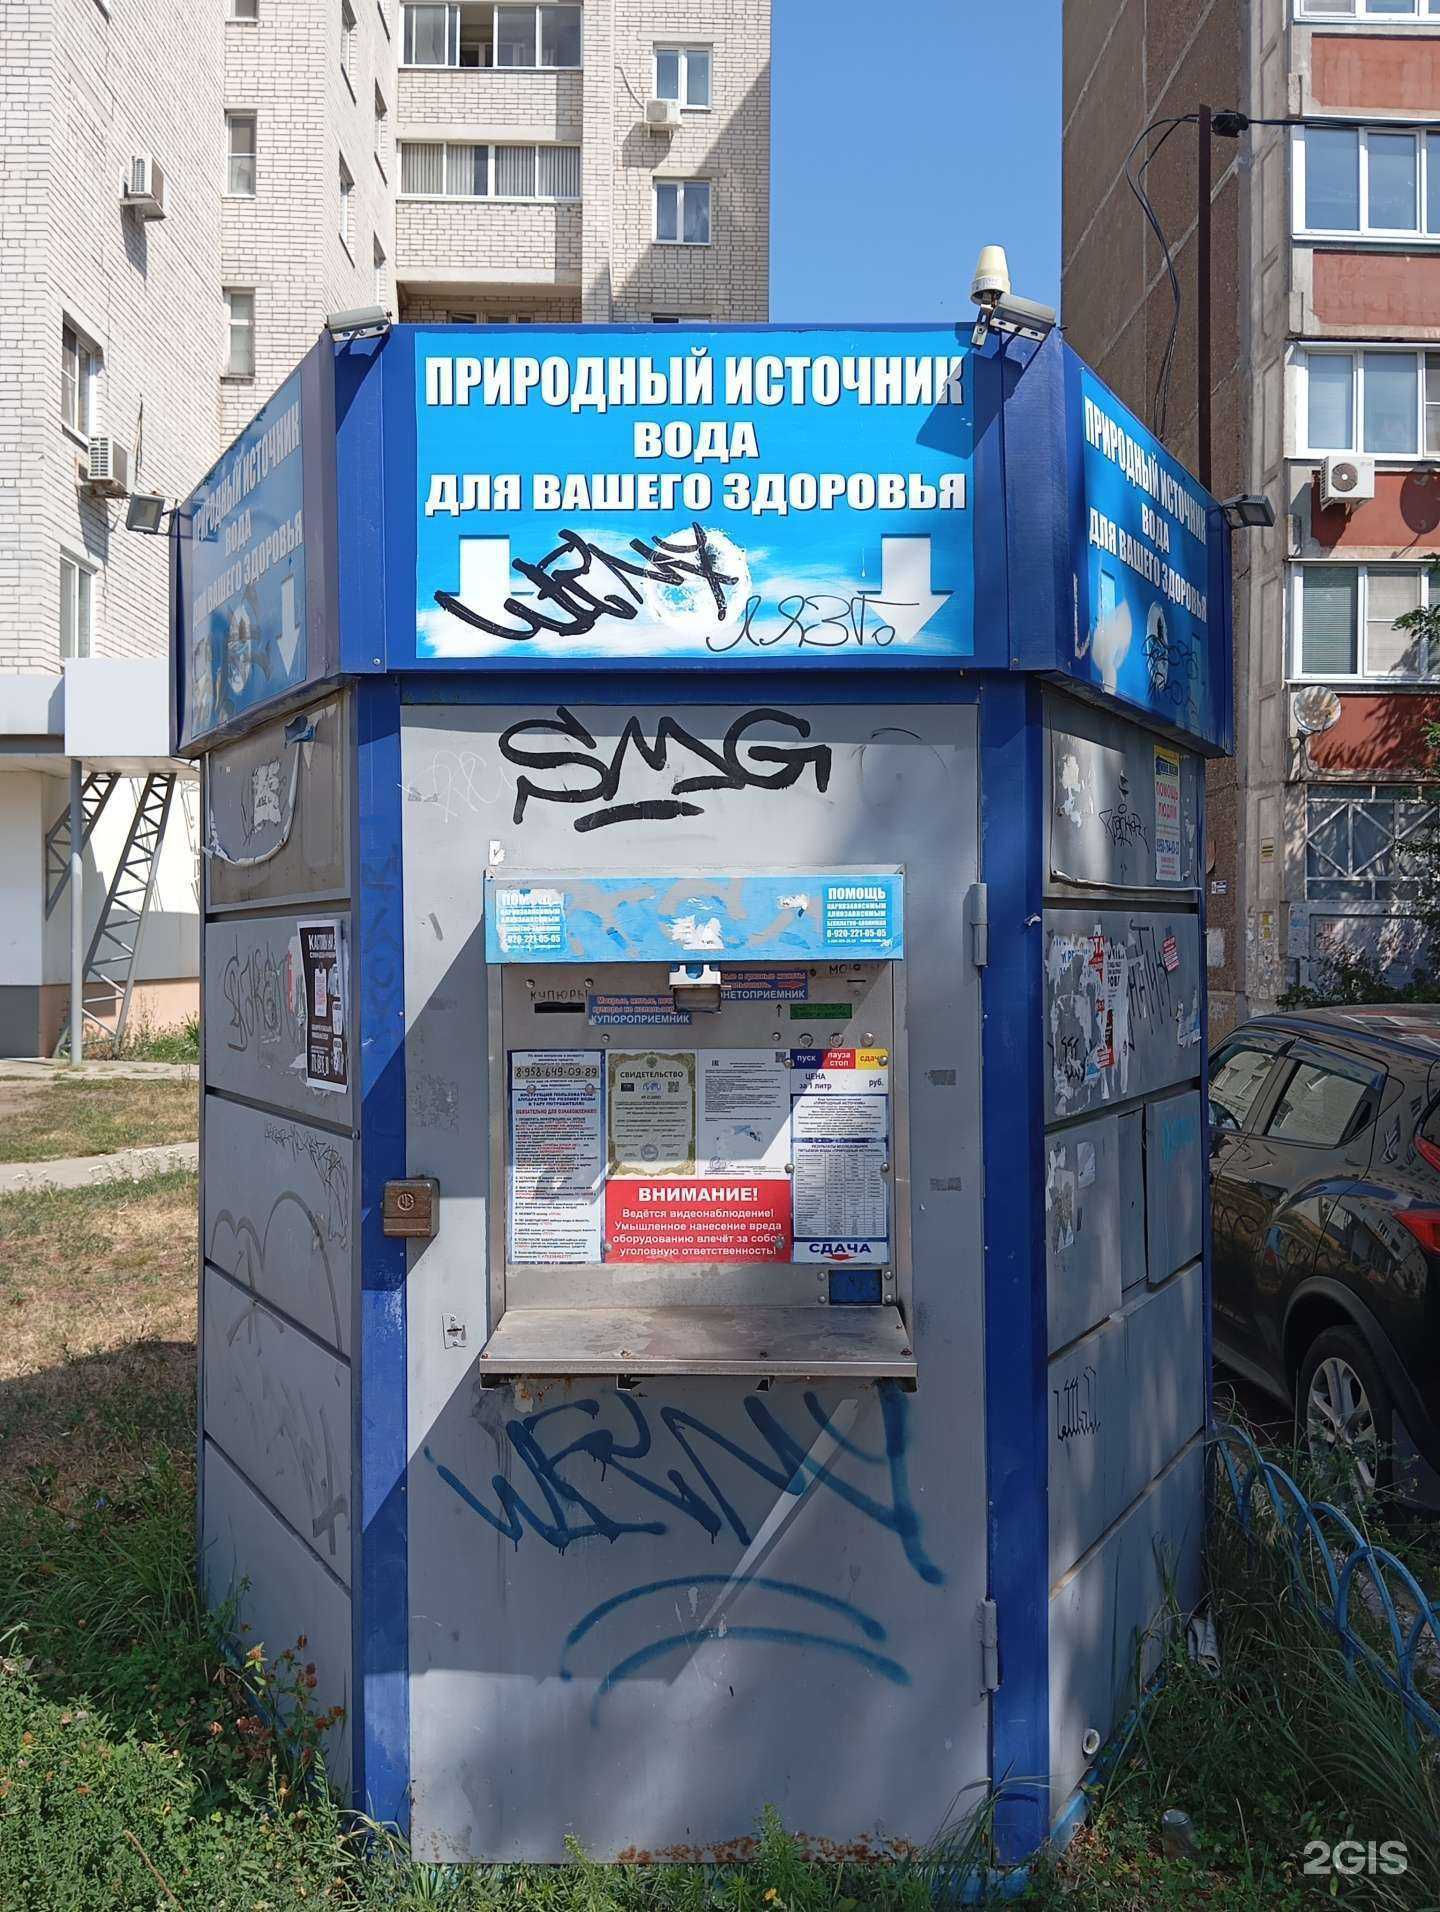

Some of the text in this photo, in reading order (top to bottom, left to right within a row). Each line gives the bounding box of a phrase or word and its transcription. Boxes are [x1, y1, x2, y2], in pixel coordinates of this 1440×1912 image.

[424, 347, 964, 413] ПРИРОДНЫЙ ИСТОЧНИК
[242, 399, 301, 494] ИСТОЧНИК
[633, 421, 758, 464] ВОДА
[1084, 395, 1207, 545] ПРИРОДНЫЙ ИСТОЧНИК
[425, 473, 968, 516] ДЛЯ ВАШЕГО ЗДОРОВЬЯ
[225, 509, 252, 557] ВОДА
[1142, 502, 1171, 553] ВОДА
[207, 562, 242, 614] ВАШЕГО
[244, 510, 304, 585] ЗДОРОВЬЯ
[1089, 506, 1207, 623] ДЛЯ ВАШЕГО ЗДОРОВЬЯ
[498, 707, 832, 824] SMG
[828, 887, 886, 901] ПОМОЩЬ
[720, 989, 806, 1000] НЕТОПРИЕМНИК
[591, 1014, 690, 1025] КУПЮРОПРИЕМНИК
[797, 1054, 817, 1063] пуск
[620, 1071, 684, 1079] СВИДЕТЕЛЬСТВО
[805, 1073, 826, 1081] ЦЕНА
[815, 1083, 832, 1091] литр
[869, 1079, 884, 1088] руб.
[638, 1187, 759, 1202] ВНИМАНИЕ!
[622, 1208, 774, 1219] Ведётся видеонаблюдение!
[614, 1221, 782, 1232] Умышленное нанесение вреда
[612, 1234, 694, 1245] оборудованию
[697, 1233, 733, 1244] влечёт
[736, 1235, 749, 1243] за
[619, 1247, 776, 1257] уголовную ответственность!
[808, 1243, 872, 1254] СДАЧА
